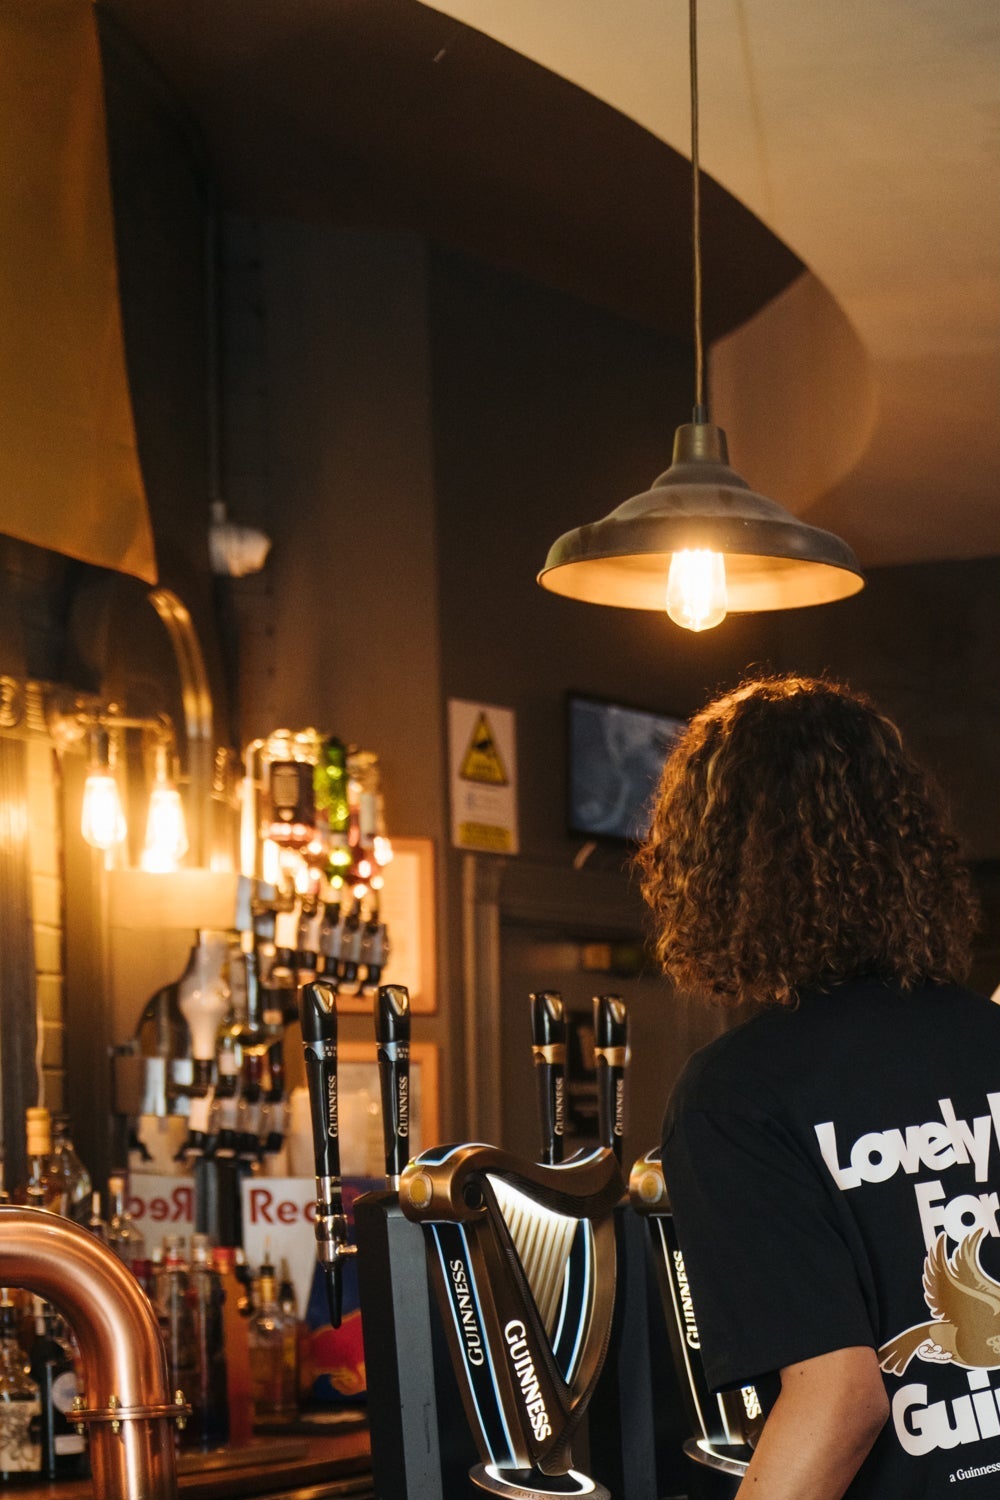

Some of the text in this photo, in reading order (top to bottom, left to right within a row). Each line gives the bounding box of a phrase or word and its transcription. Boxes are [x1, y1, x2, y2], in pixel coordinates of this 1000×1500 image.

[328, 1075, 338, 1137] GUINNESS
[398, 1076, 408, 1137] GUINNESS
[554, 1077, 564, 1136] GUINNESS
[814, 1098, 991, 1191] Lovely
[914, 1180, 1000, 1252] For
[450, 1258, 484, 1366] GUINNESS
[504, 1319, 552, 1442] GUINNESS
[949, 1473, 956, 1483] a
